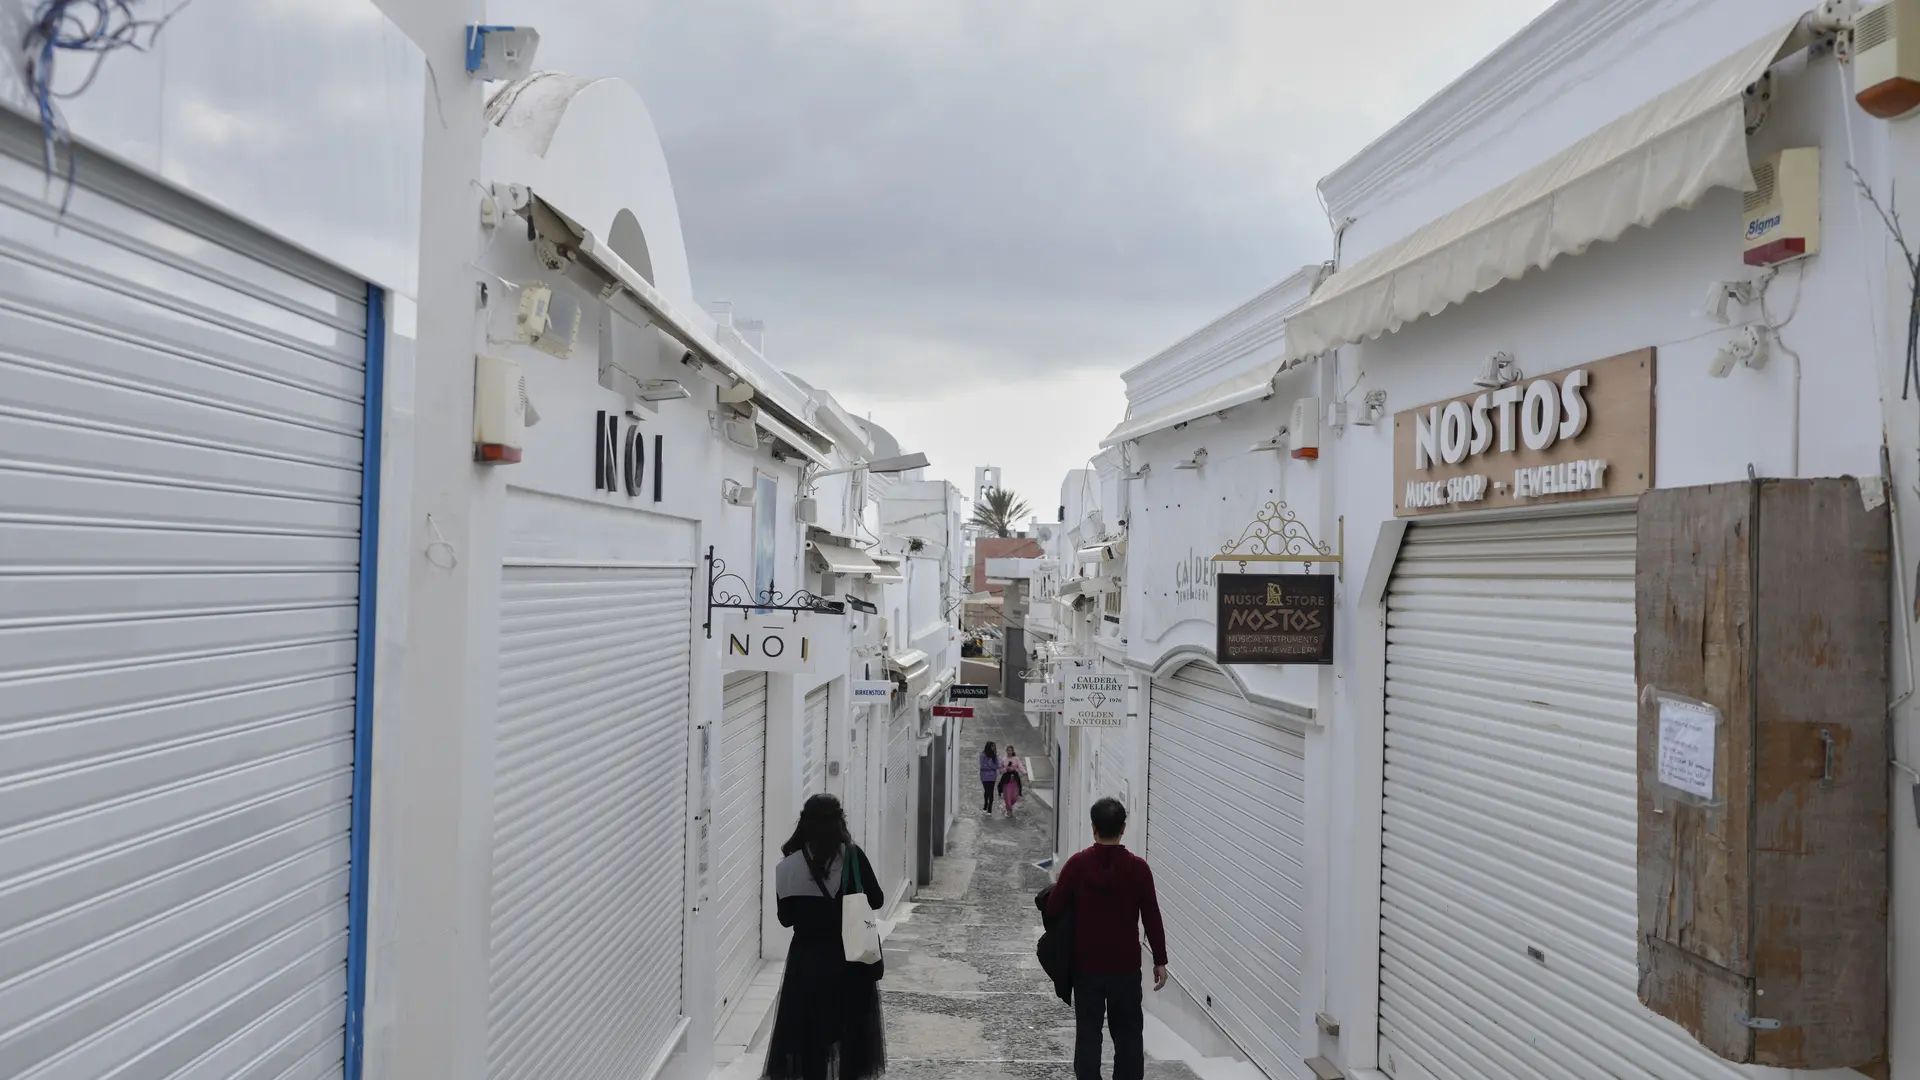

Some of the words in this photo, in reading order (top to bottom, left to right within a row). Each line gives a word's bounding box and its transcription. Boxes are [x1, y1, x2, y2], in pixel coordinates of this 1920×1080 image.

[1748, 215, 1781, 235] Sigma
[1415, 369, 1588, 470] NOSTOS
[1405, 480, 1446, 508] MUSIC
[1447, 474, 1488, 502] SHOP
[1513, 458, 1607, 500] JEWELLERY
[1224, 593, 1264, 606] MUSIC
[1285, 595, 1325, 606] STORE
[1227, 608, 1322, 632] NOSTOS
[1228, 635, 1263, 644] MUSICAL
[1264, 635, 1319, 644] INSTRUMENTS
[1077, 676, 1118, 684] CALDERA
[1071, 683, 1123, 691] JEWELLERY
[1069, 718, 1122, 726] SANTORINI
